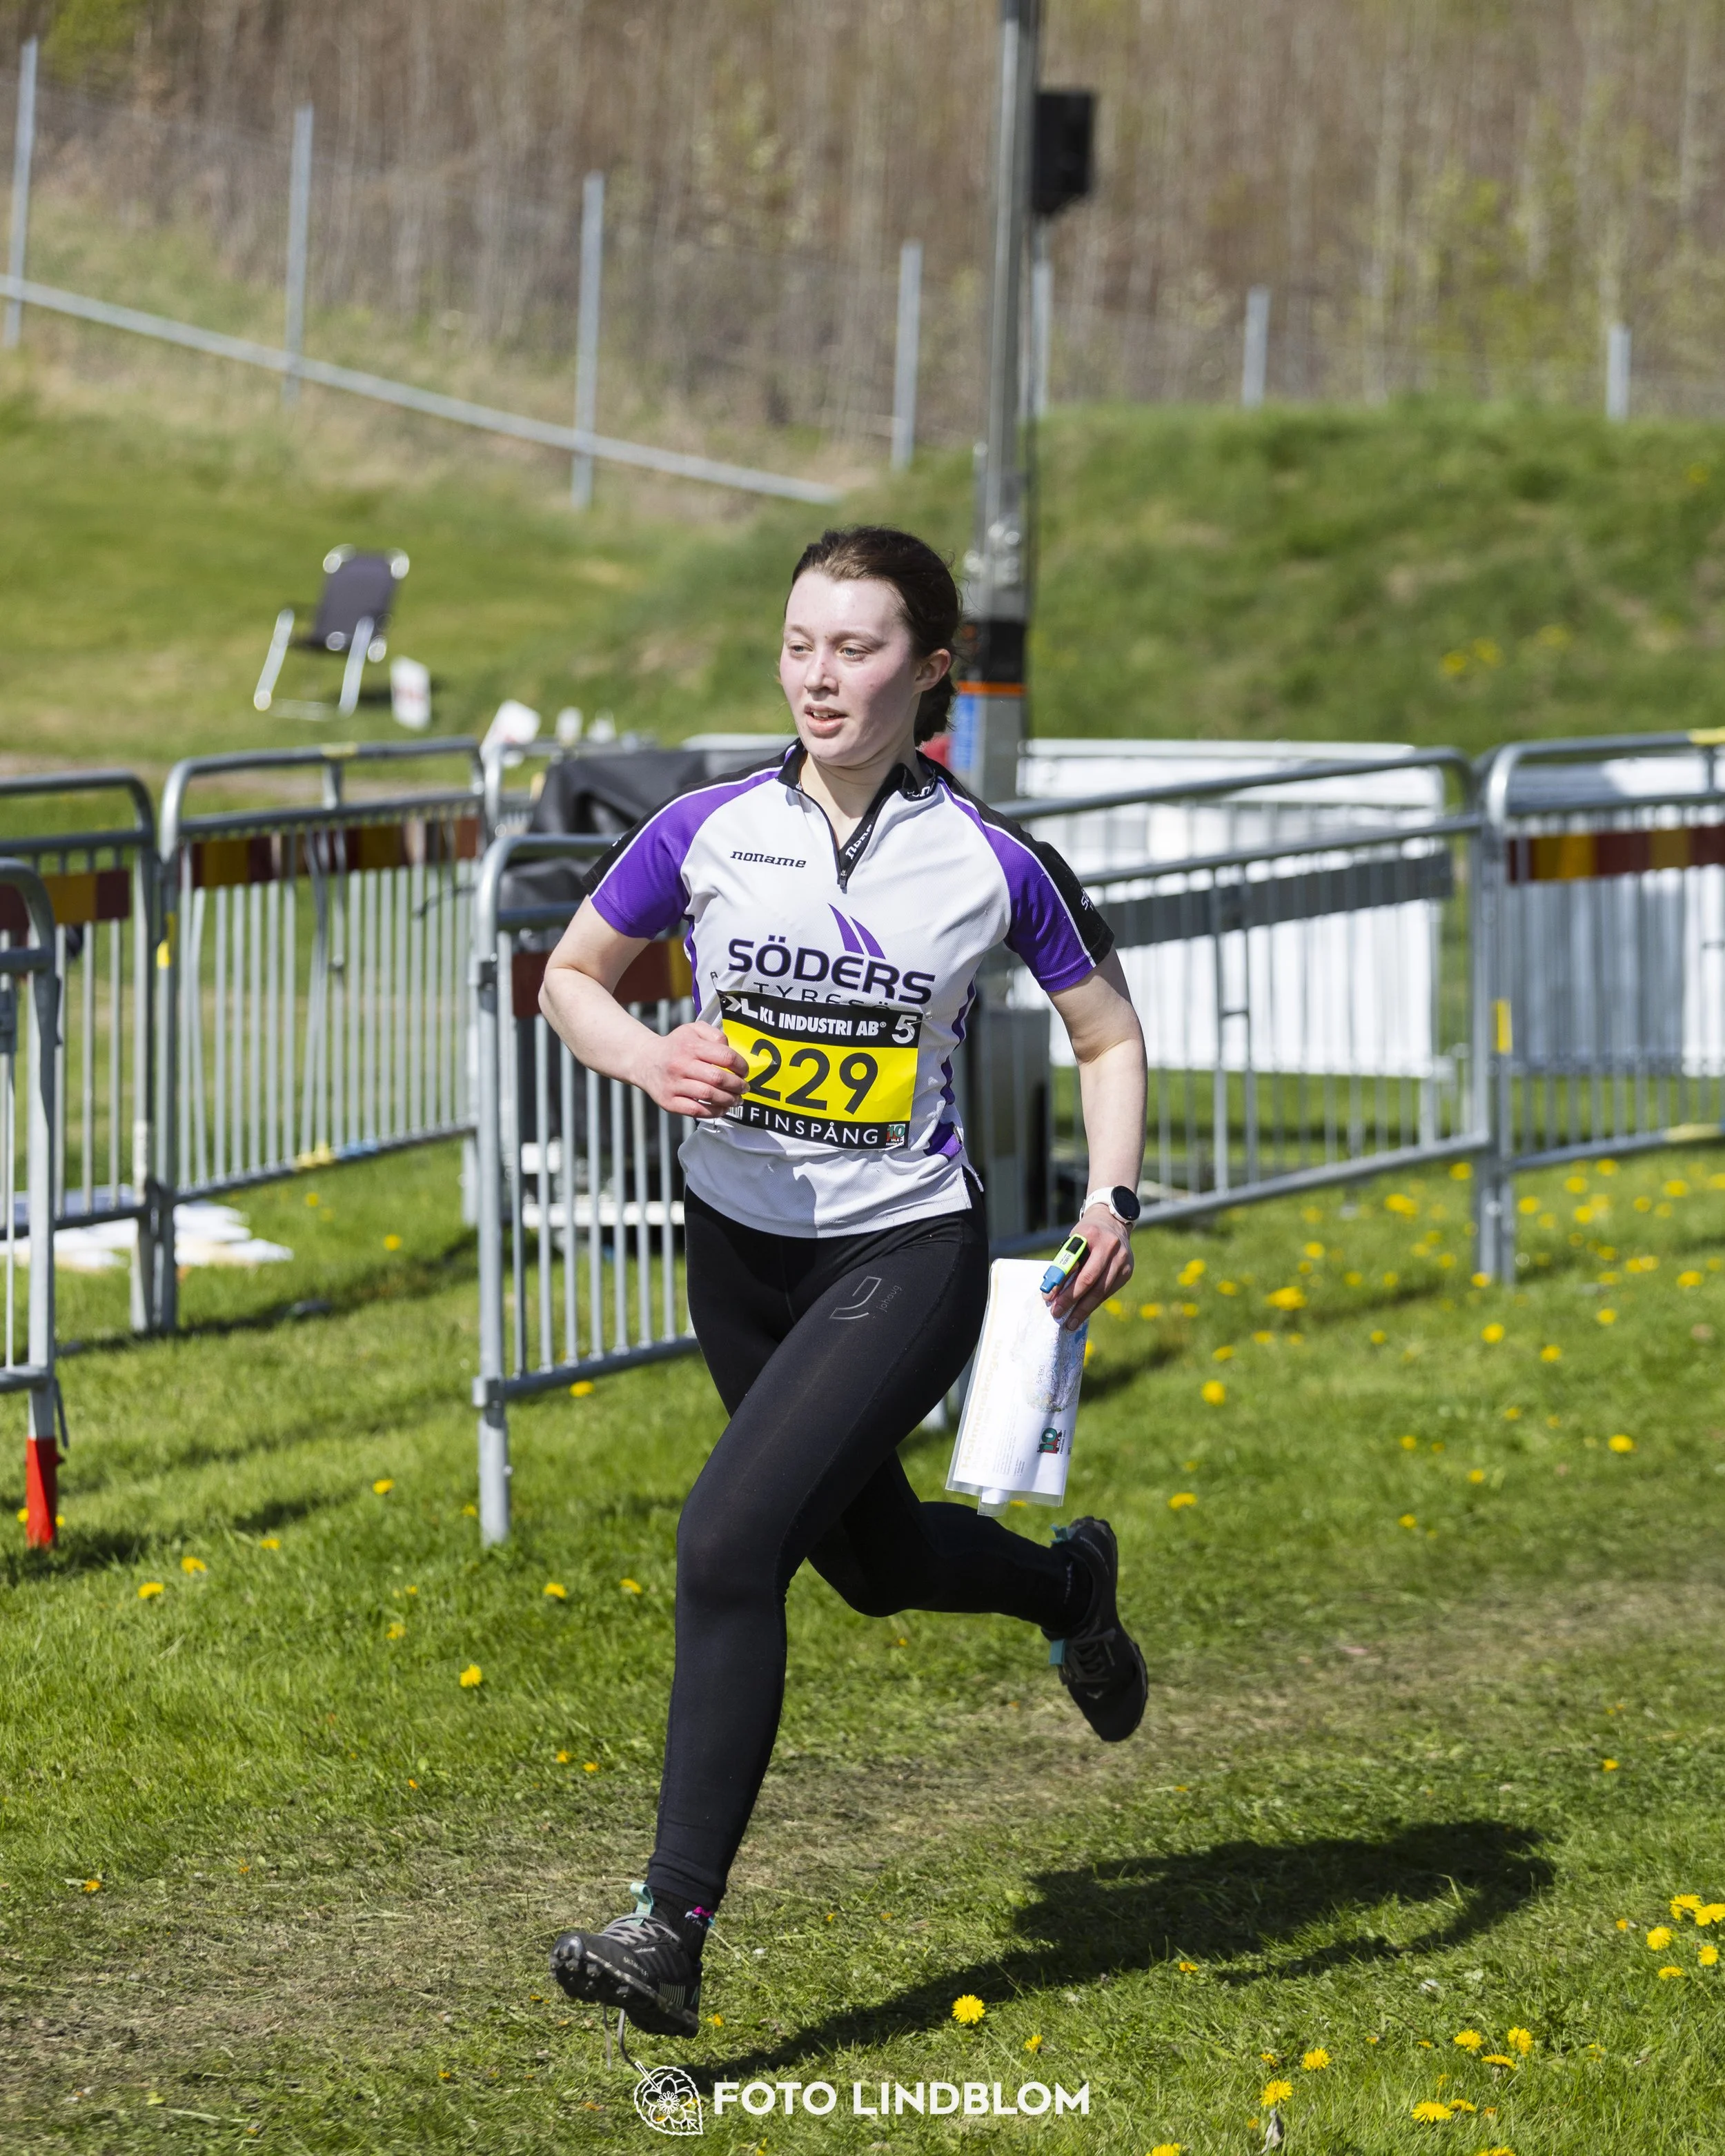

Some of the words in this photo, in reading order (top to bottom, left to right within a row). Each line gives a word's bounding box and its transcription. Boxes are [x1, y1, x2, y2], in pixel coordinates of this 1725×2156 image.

[730, 851, 807, 868] noname
[728, 934, 936, 1005] SÖDERS
[760, 1006, 775, 1026] KL
[779, 1012, 852, 1036] INDUSTRI
[892, 1014, 918, 1044] 5
[749, 1038, 878, 1115] 229
[750, 1107, 878, 1145] FINSPÅNG
[887, 1125, 905, 1138] 10
[876, 1285, 902, 1312] johaug
[1037, 1427, 1058, 1453] 10
